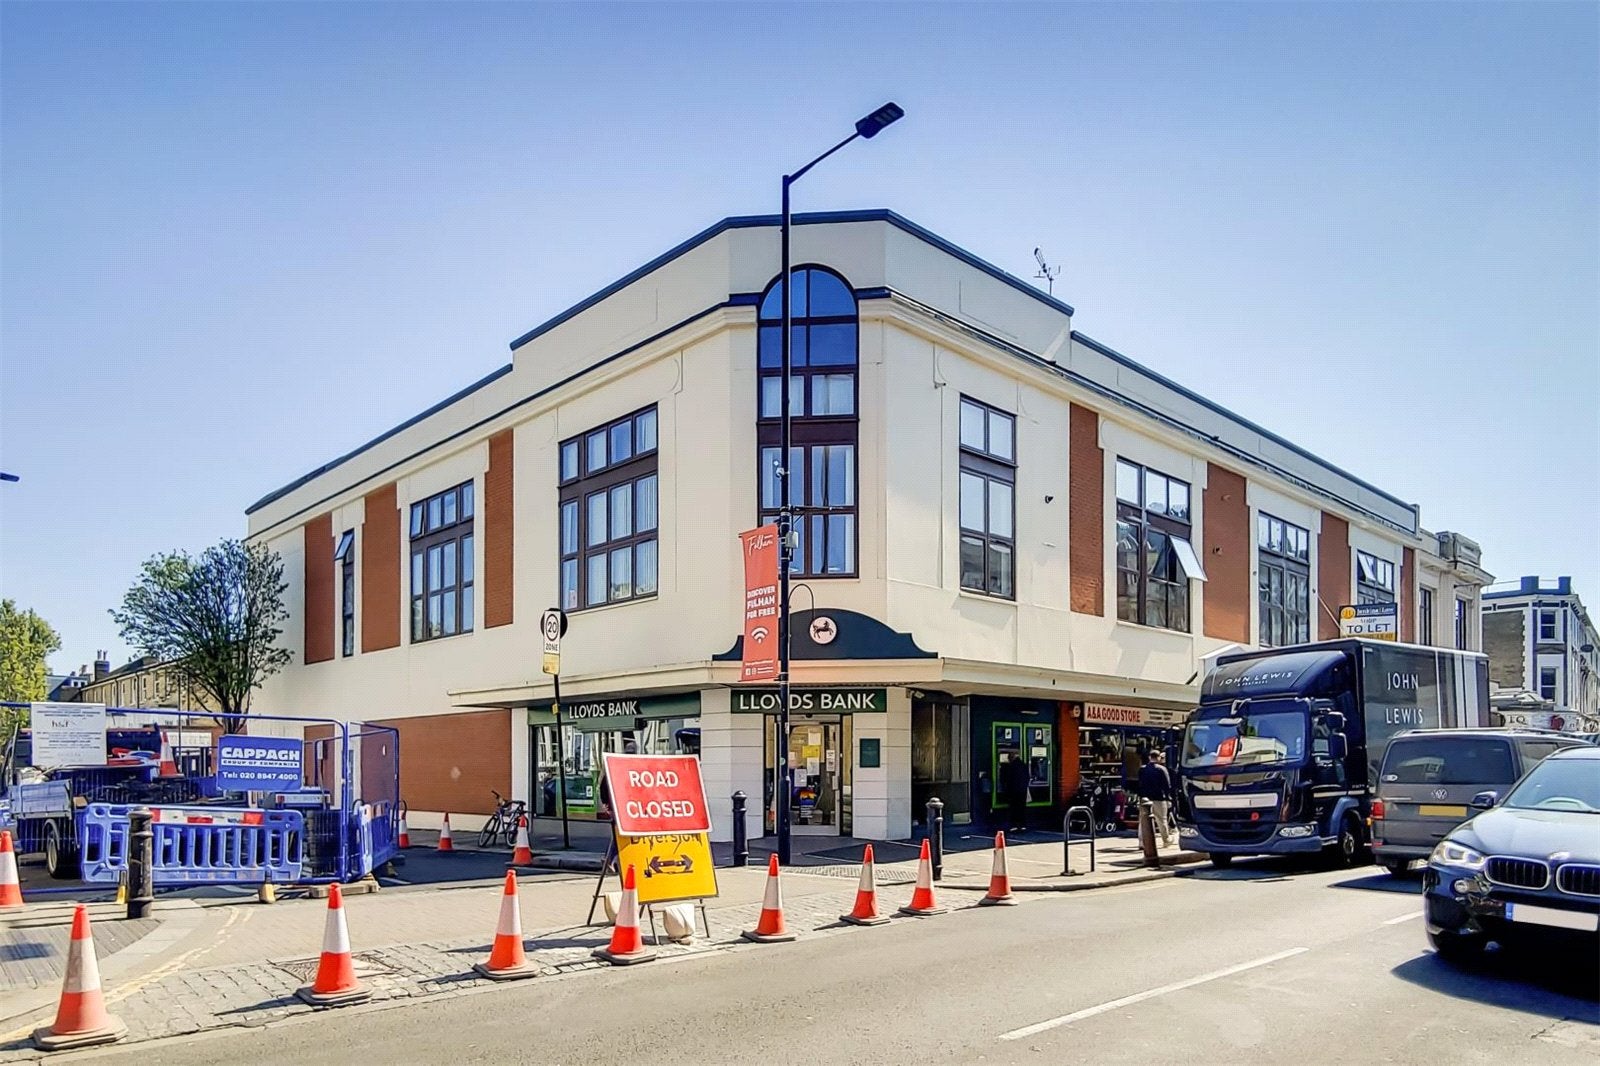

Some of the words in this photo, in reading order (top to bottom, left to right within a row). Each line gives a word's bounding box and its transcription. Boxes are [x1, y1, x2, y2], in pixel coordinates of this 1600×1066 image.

[747, 586, 776, 598] DISCOVER
[747, 596, 775, 610] FULHAM
[747, 609, 757, 620] FOR
[758, 607, 776, 617] FREE
[547, 621, 557, 633] 20
[1347, 625, 1363, 634] TO
[1368, 623, 1391, 632] LET
[545, 642, 558, 651] ZONE
[1219, 676, 1250, 687] JOHN
[1254, 671, 1293, 681] LEWIS
[1387, 672, 1419, 690] JOHN
[820, 693, 876, 709] BANK
[568, 702, 606, 719] LLOYDS
[607, 700, 637, 717] BANK
[1087, 706, 1101, 720] A&A
[1102, 706, 1120, 721] GOOD
[1120, 708, 1141, 722] STORE
[1385, 708, 1423, 724] LEWIS
[221, 747, 300, 761] CAPPAGH
[628, 770, 679, 788] ROAD
[626, 800, 695, 819] CLOSED
